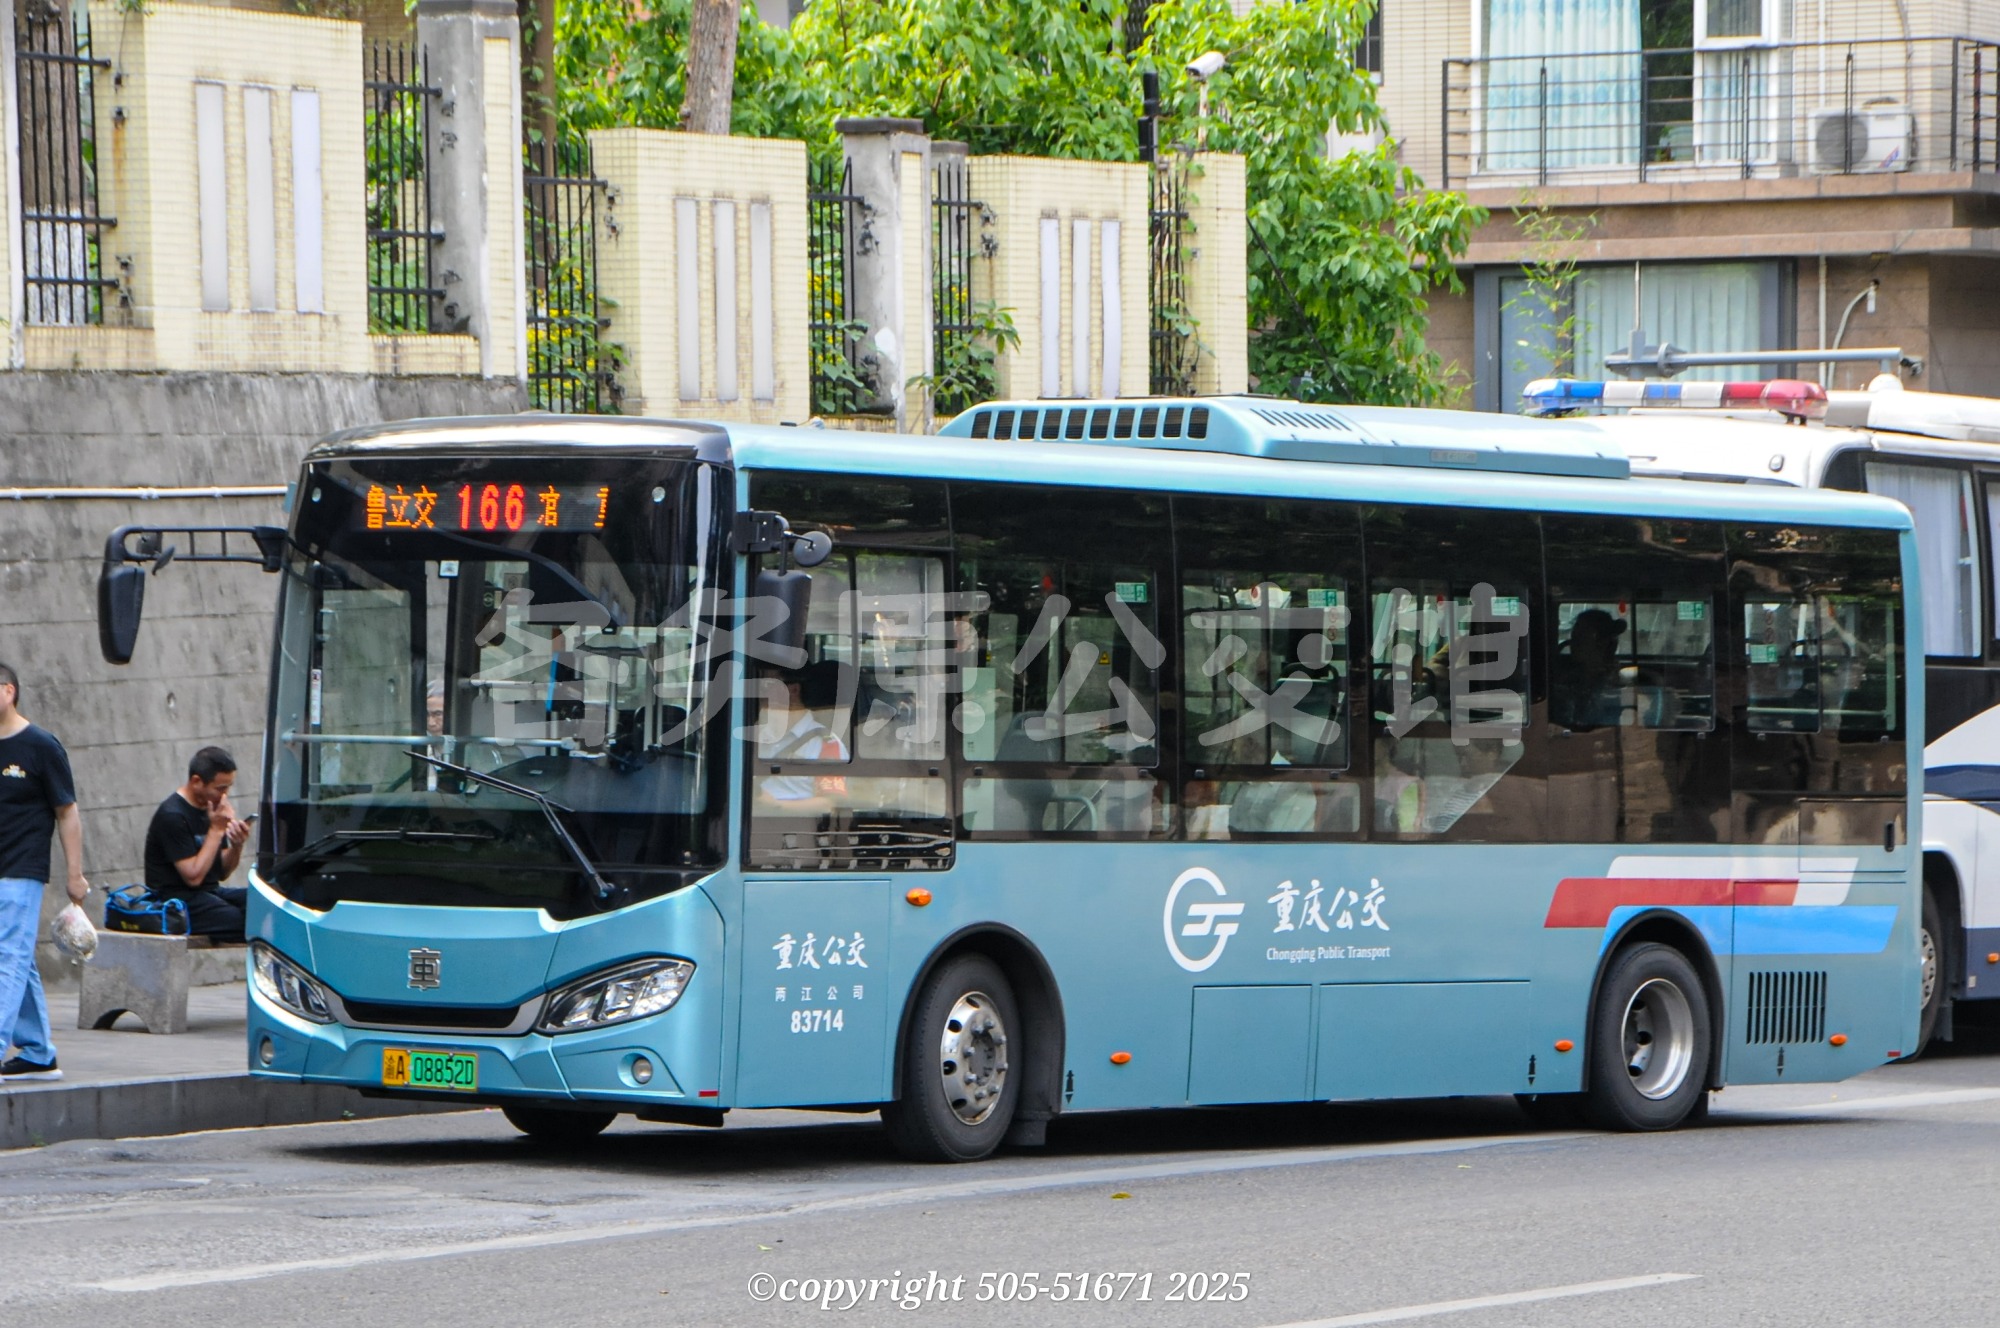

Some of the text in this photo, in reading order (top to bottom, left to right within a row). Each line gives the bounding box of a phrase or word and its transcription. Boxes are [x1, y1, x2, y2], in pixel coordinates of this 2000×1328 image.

[457, 483, 525, 531] 166
[1267, 878, 1390, 933] 重庆公交
[772, 932, 868, 970] 重庆公交
[1266, 945, 1391, 963] Chongqing Public Transport
[791, 1009, 844, 1033] 83714
